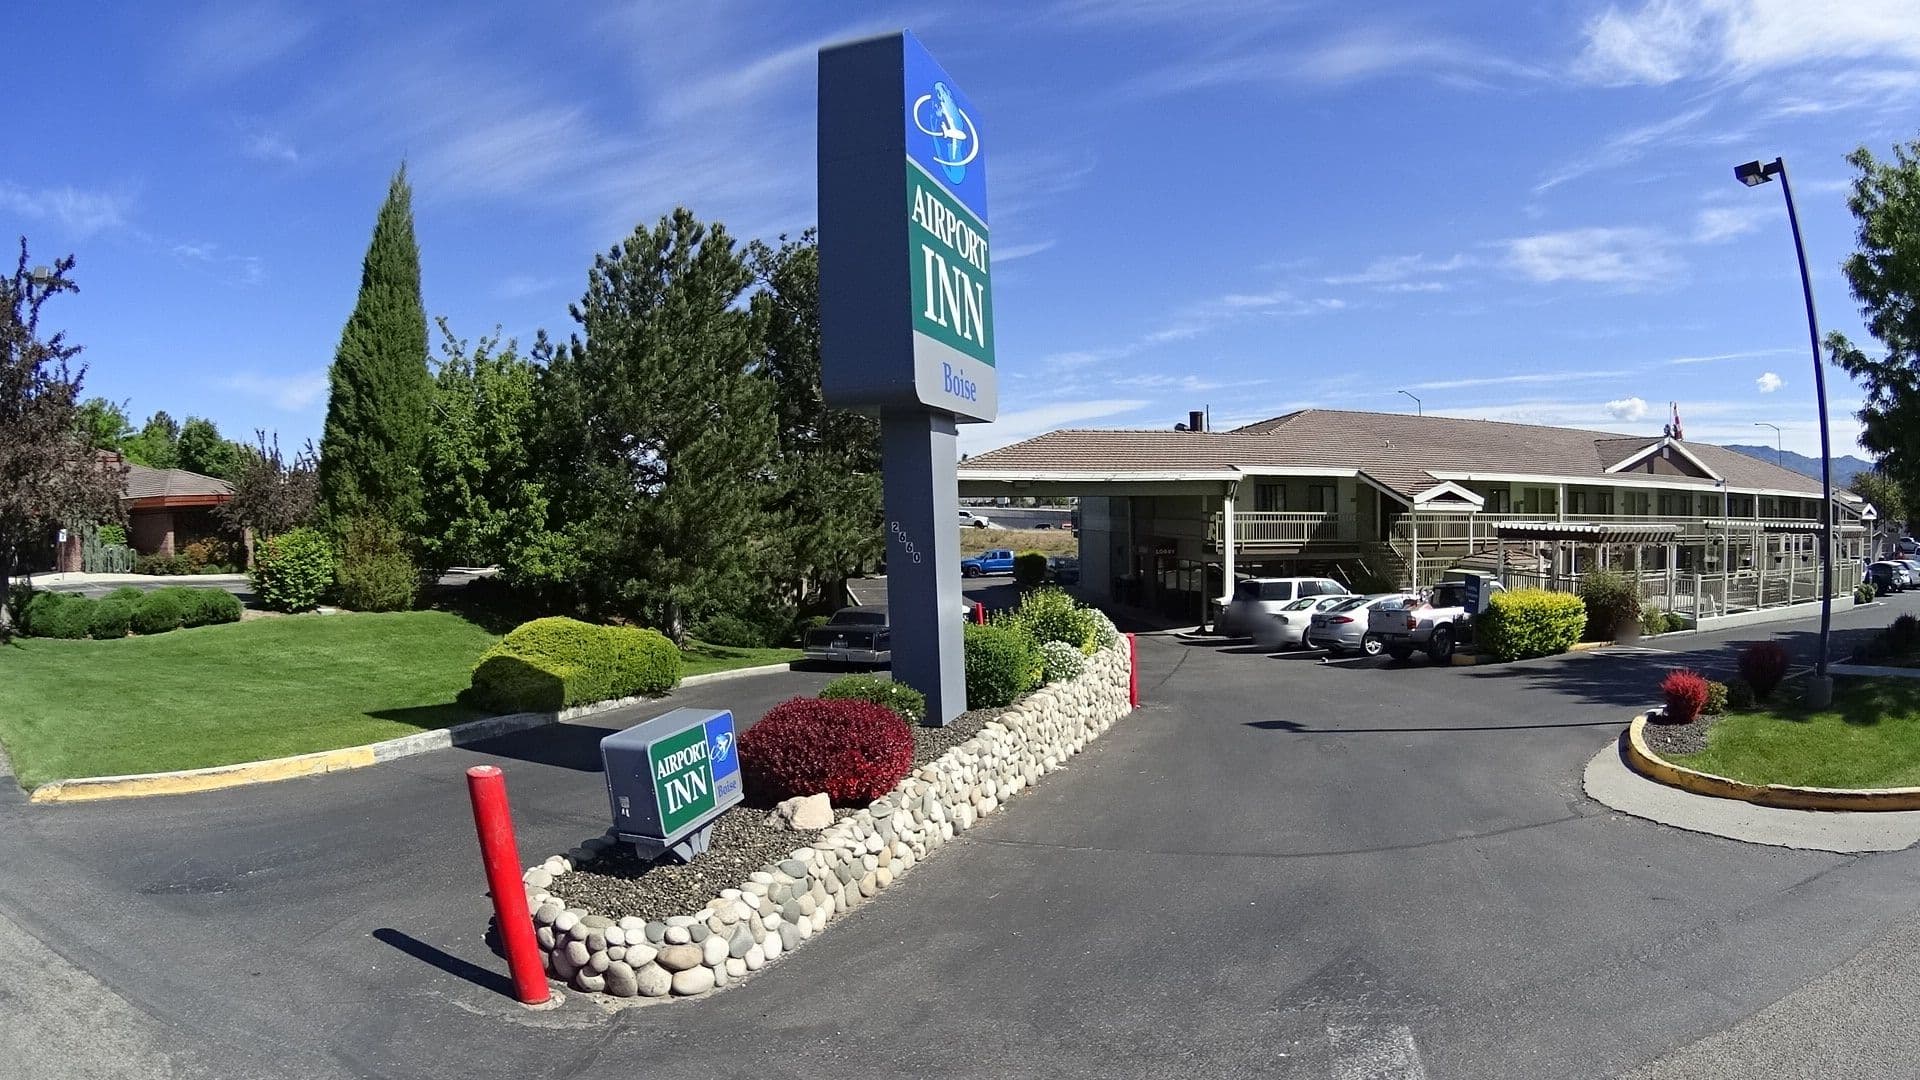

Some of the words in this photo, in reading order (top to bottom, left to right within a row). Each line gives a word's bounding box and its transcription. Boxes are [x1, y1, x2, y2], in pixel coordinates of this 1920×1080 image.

[912, 184, 988, 274] AIRPORT
[922, 243, 985, 349] INN
[942, 361, 977, 402] Boise
[891, 521, 921, 563] 2660
[657, 740, 707, 780] AIRPORT
[664, 765, 708, 814] INN
[717, 780, 737, 798] Boise
